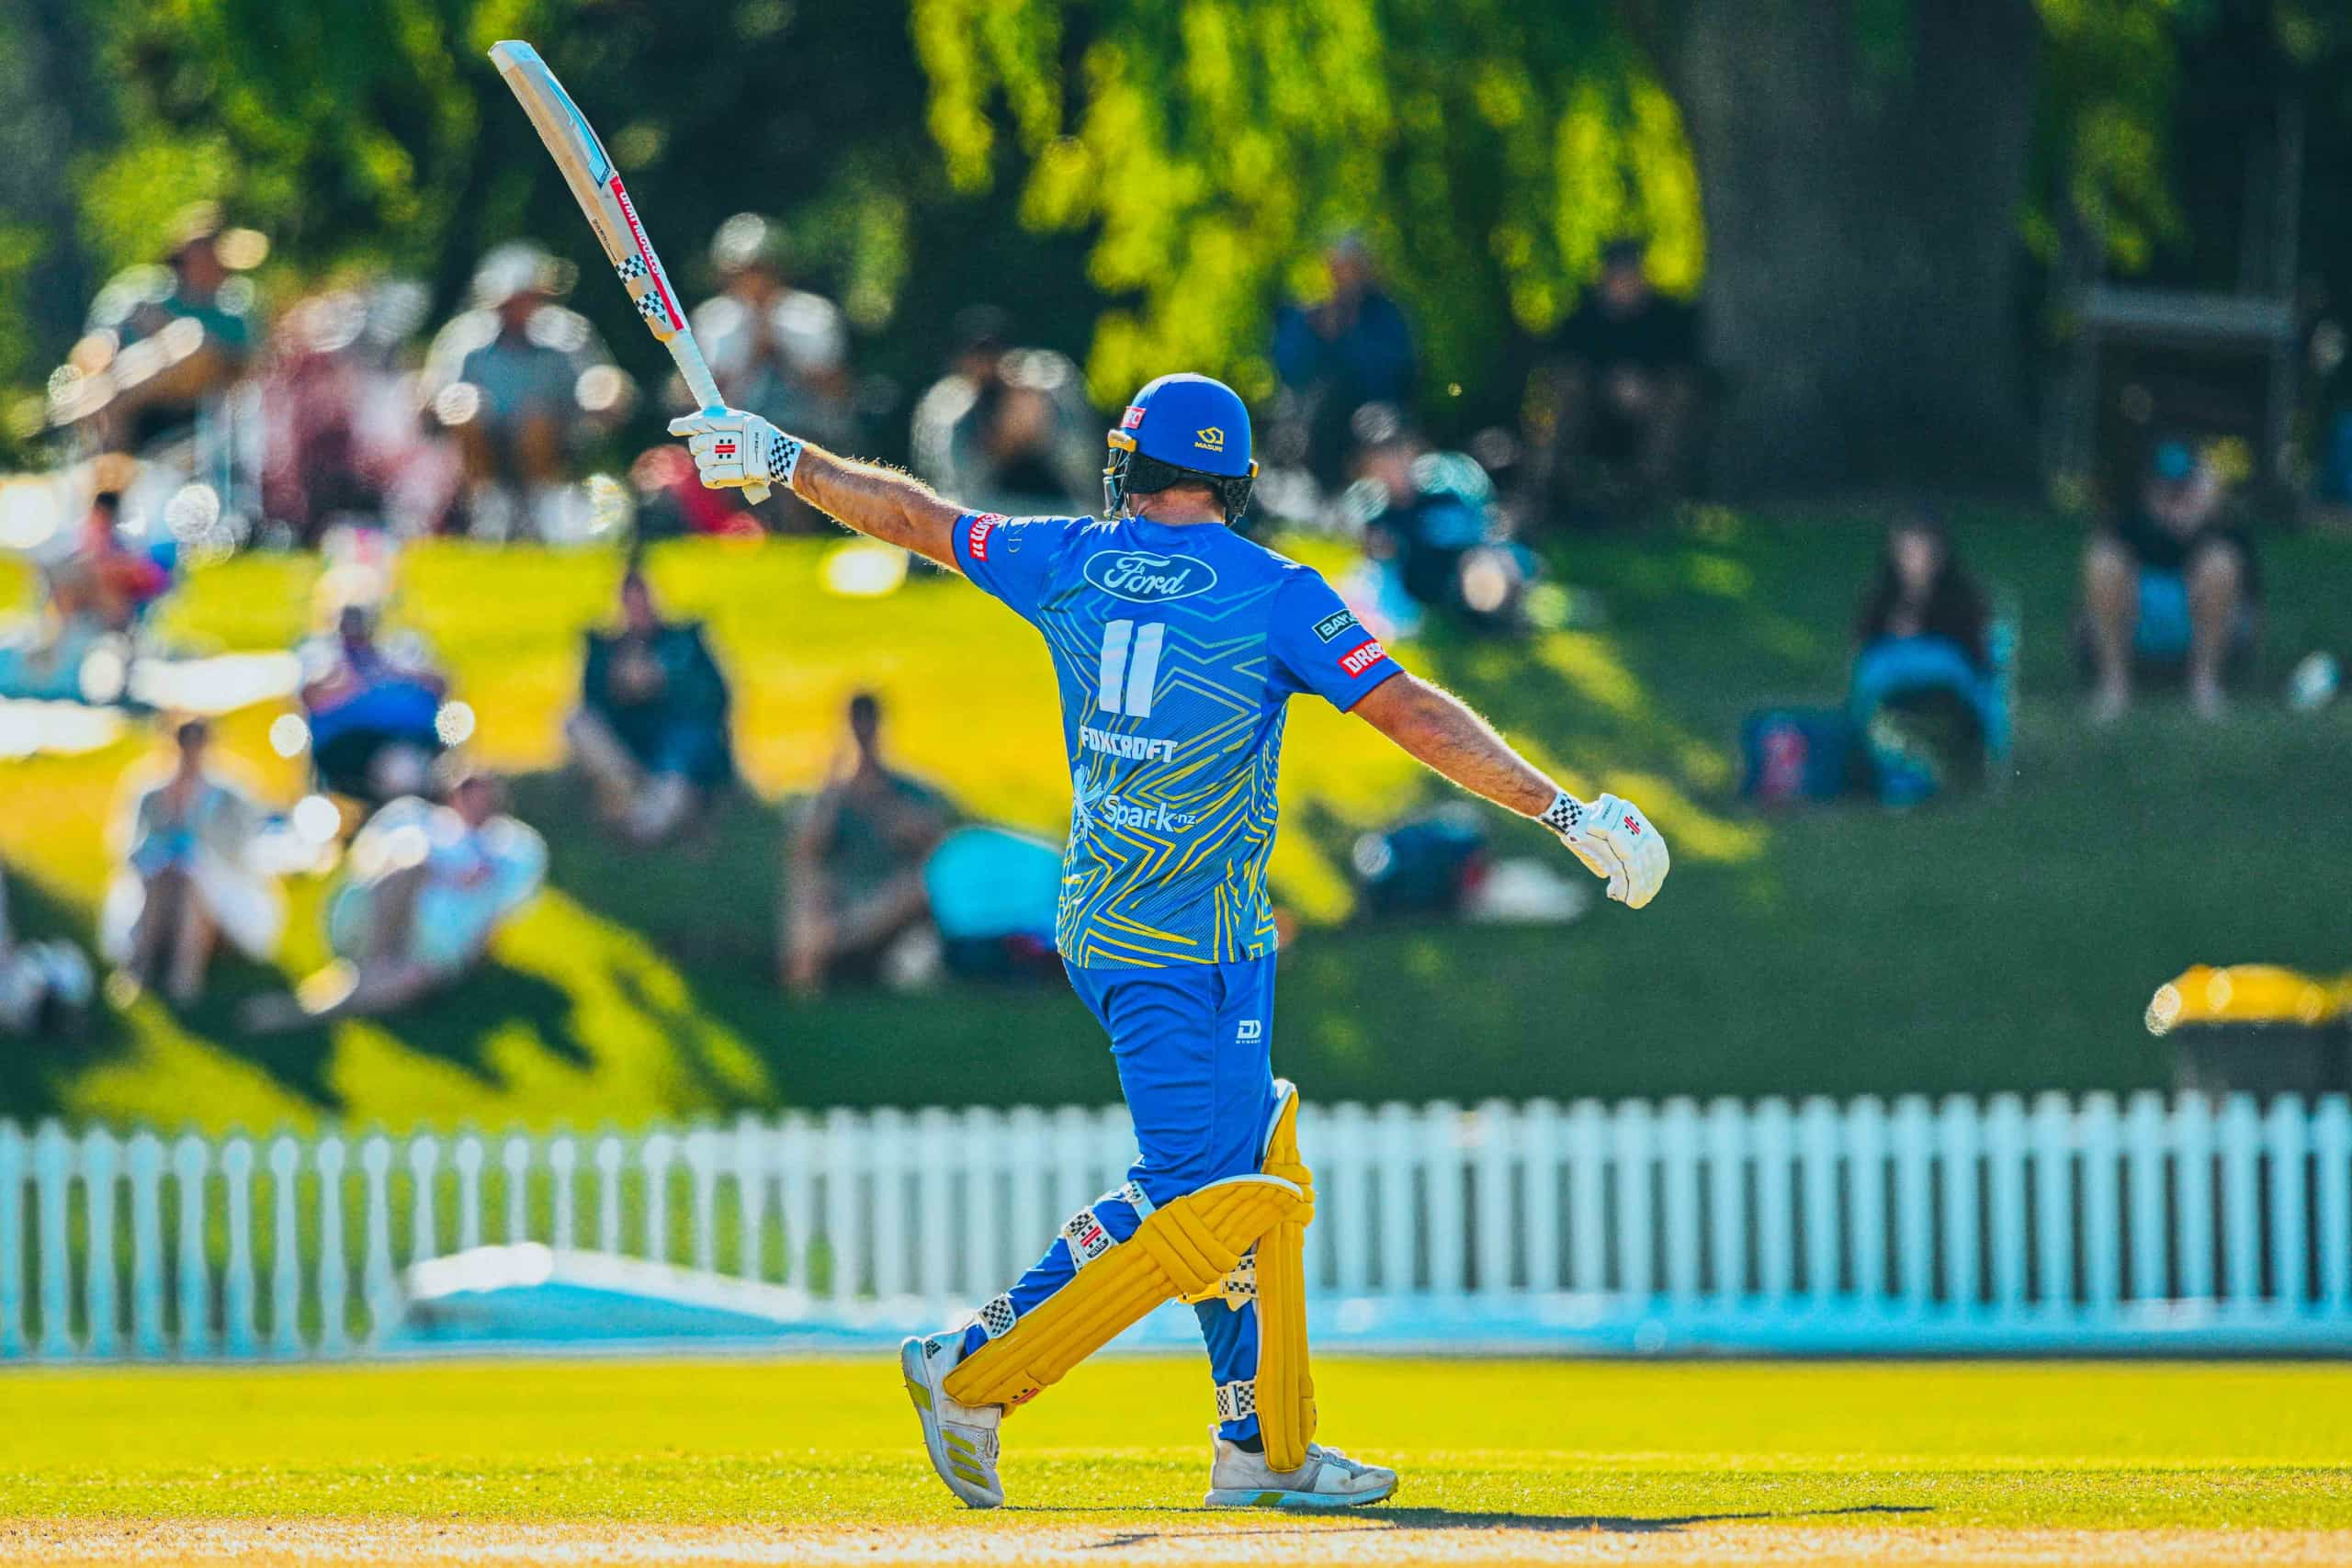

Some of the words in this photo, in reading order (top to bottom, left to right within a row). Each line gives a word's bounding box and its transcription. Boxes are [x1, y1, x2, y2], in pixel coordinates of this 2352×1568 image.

[1103, 557, 1191, 594] Ford
[1099, 619, 1165, 718] 11
[1080, 725, 1178, 763] FOXCROFT
